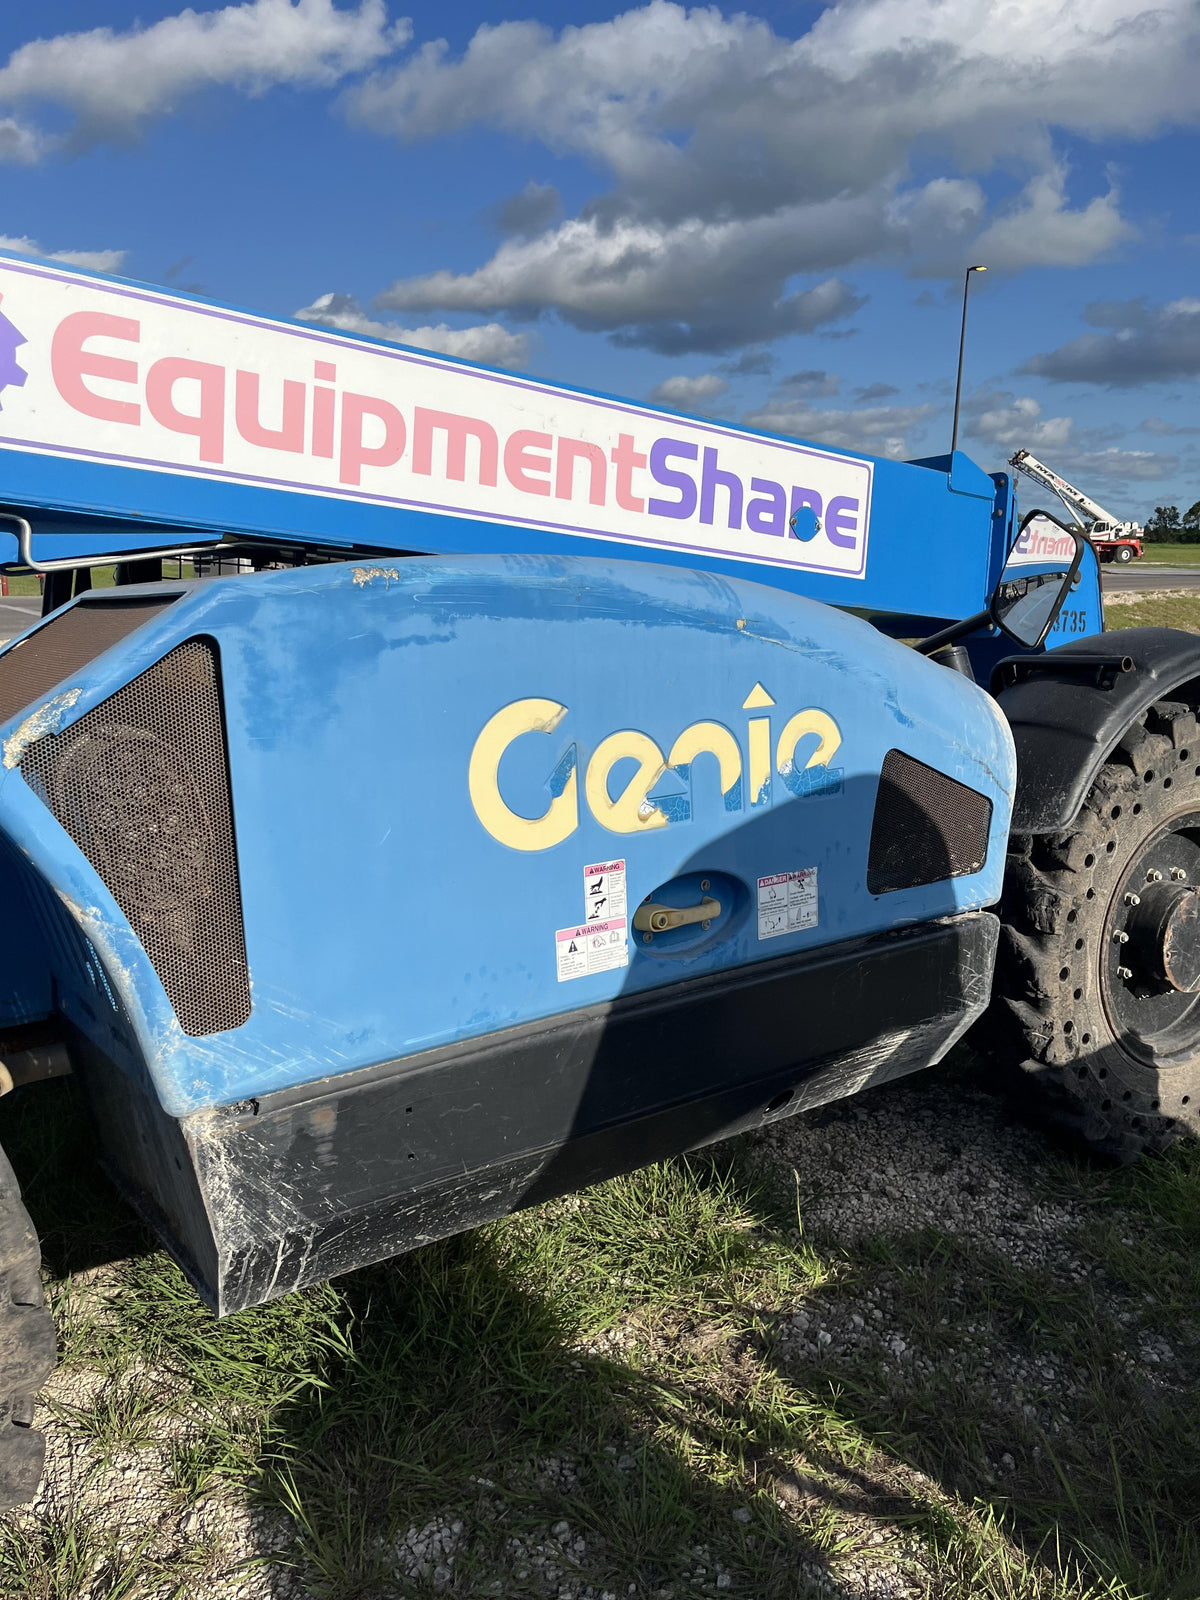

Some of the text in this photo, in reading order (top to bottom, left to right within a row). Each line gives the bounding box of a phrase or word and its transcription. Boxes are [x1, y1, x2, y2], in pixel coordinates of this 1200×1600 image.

[51, 311, 859, 549] EquipmentShare
[470, 682, 844, 851] Genie
[581, 923, 609, 935] WARNING
